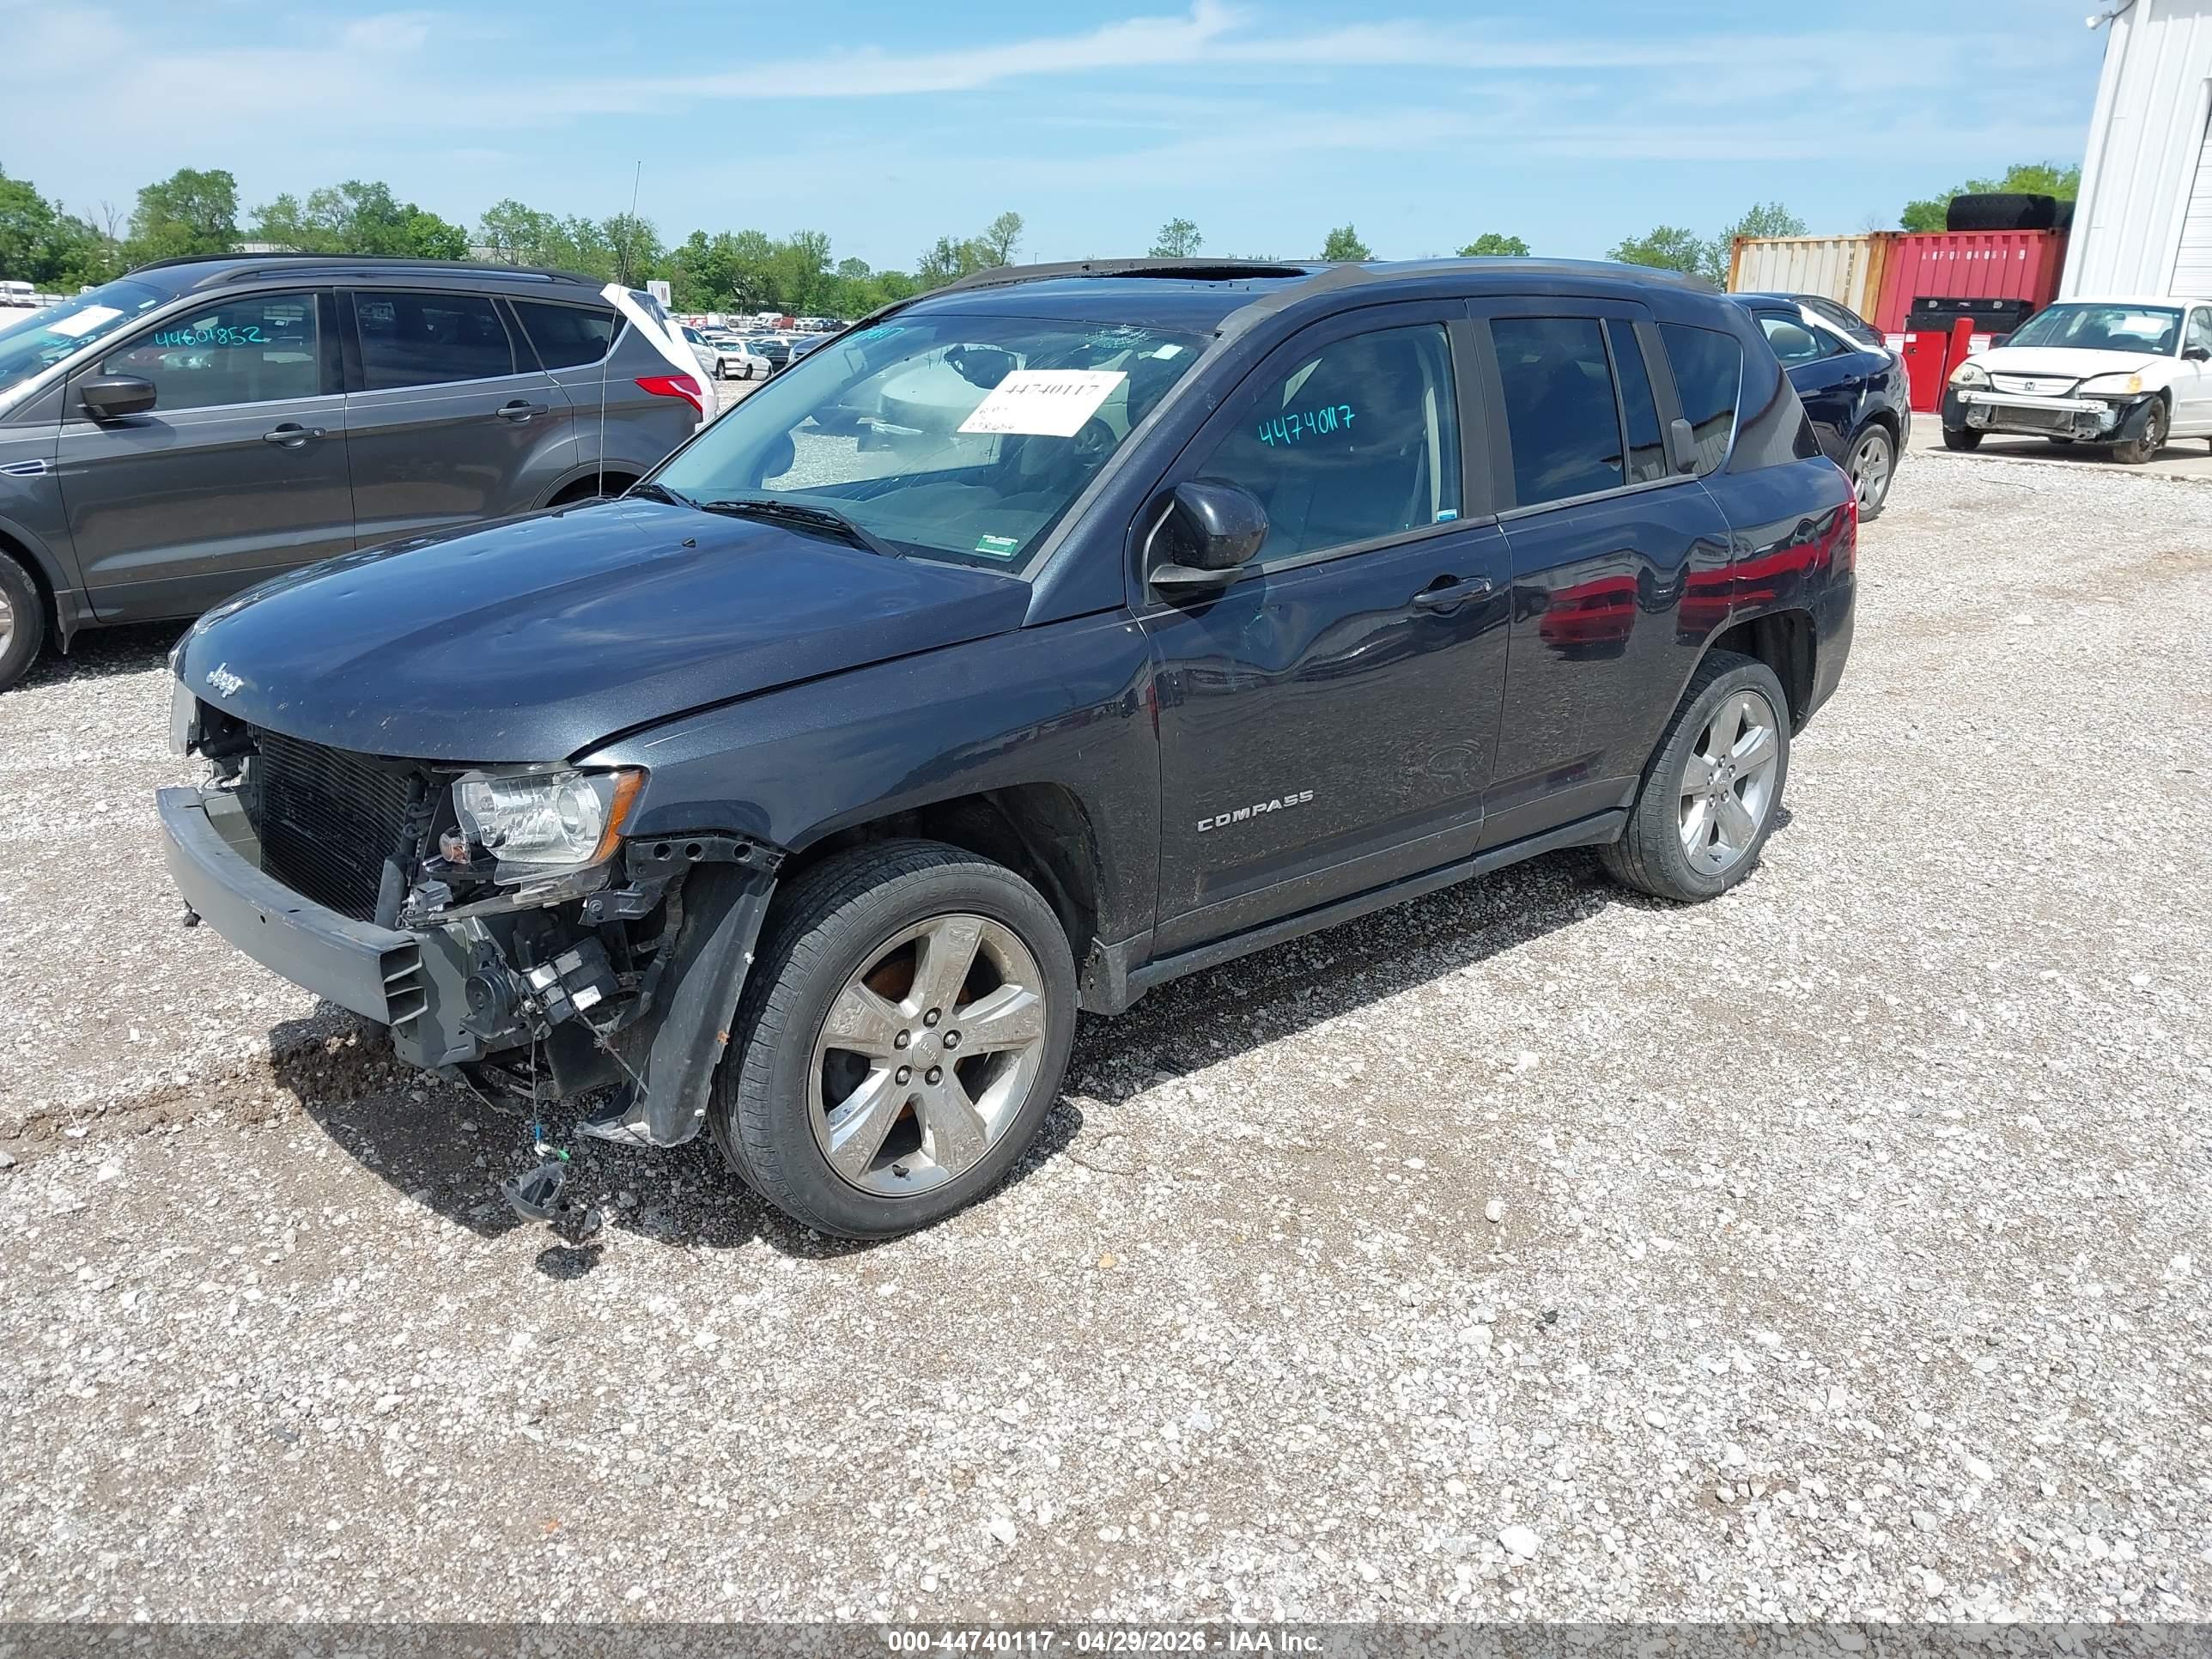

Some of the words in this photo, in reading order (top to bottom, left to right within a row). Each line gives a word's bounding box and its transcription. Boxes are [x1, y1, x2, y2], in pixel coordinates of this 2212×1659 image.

[155, 326, 271, 349] 44601852
[1005, 384, 1100, 396] 44740117
[1258, 405, 1356, 447] 44740117
[206, 662, 245, 699] Jeep
[1197, 790, 1314, 832] COMPASS
